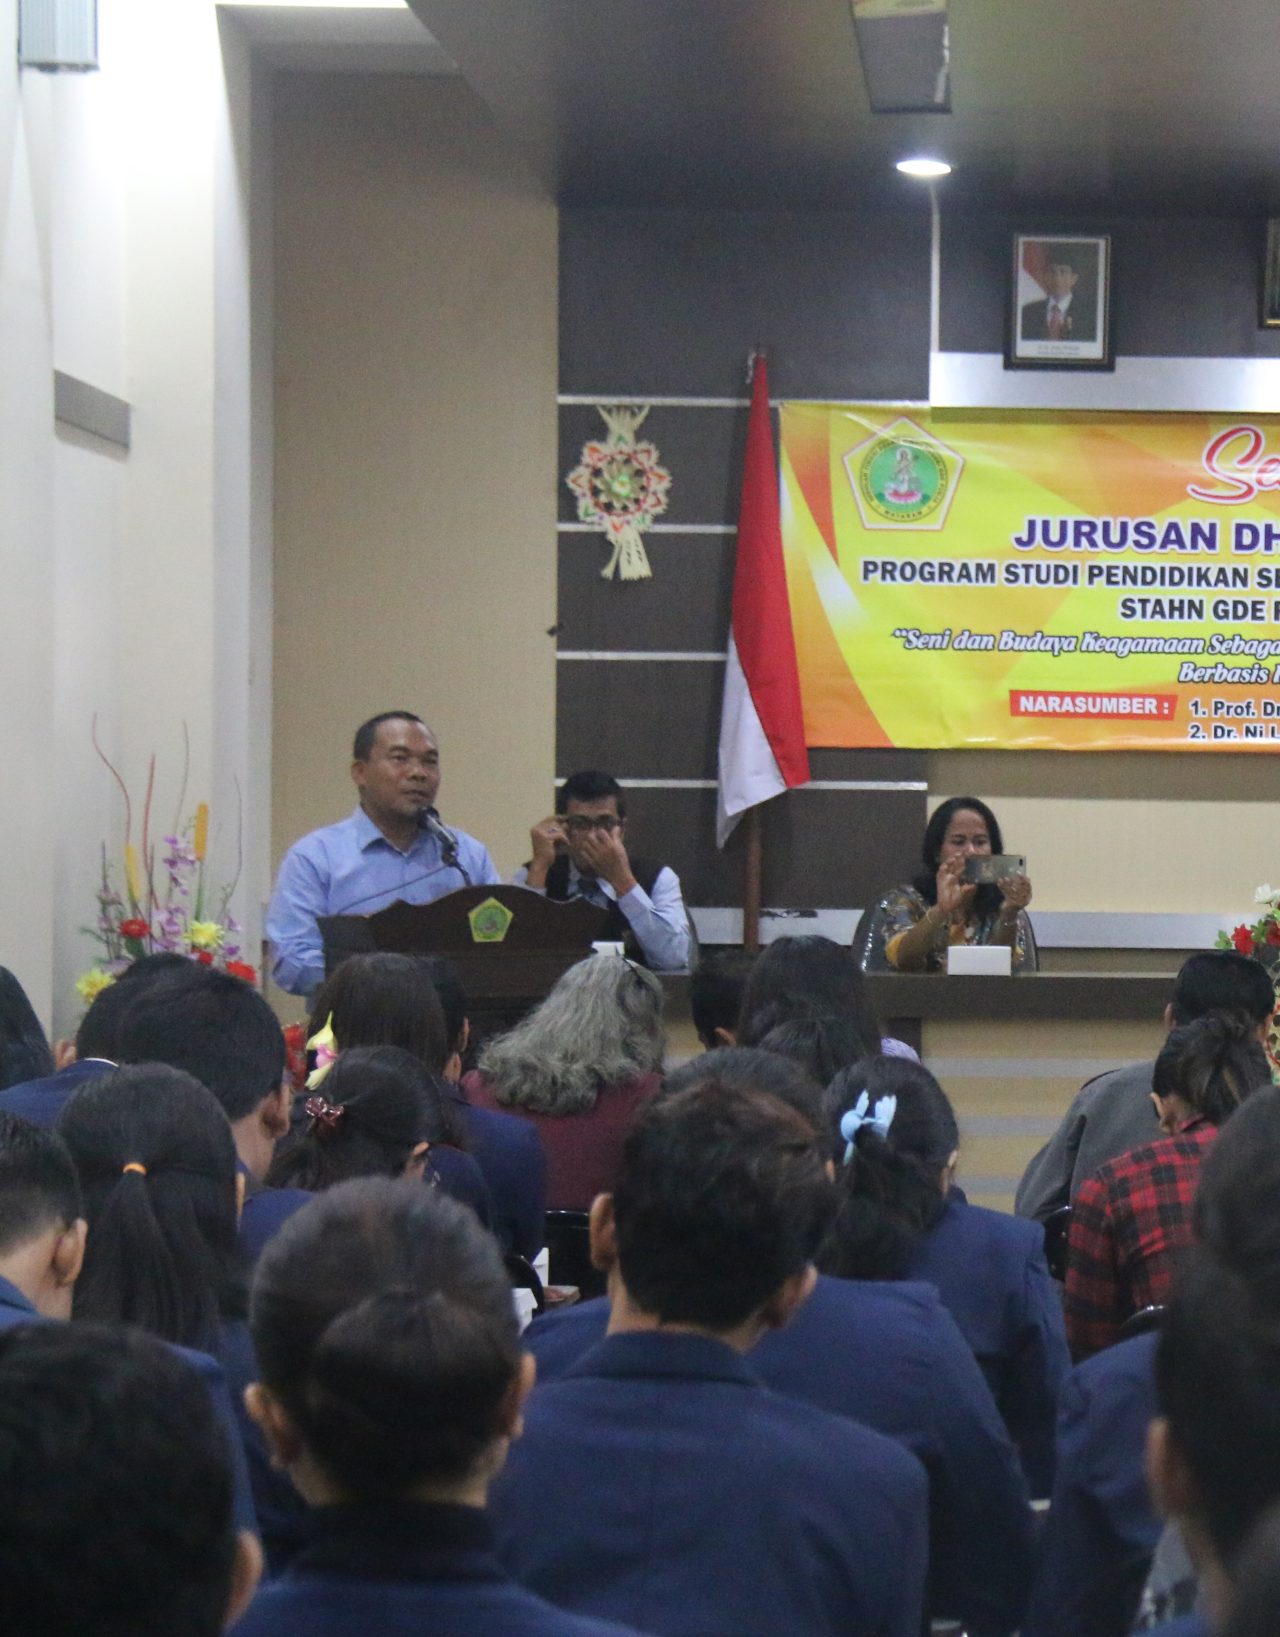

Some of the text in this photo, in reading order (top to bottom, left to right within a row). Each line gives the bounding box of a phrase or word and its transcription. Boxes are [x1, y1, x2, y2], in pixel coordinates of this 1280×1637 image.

[1014, 519, 1218, 551] JURUSAN
[862, 560, 996, 584] PROGRAM
[1003, 563, 1079, 586] STUDI
[1087, 565, 1249, 589] PENDIDIKAN
[1120, 598, 1205, 621] STAHN
[1212, 600, 1266, 622] GDE
[952, 629, 995, 651] dan
[998, 630, 1077, 657] Budaya
[1081, 632, 1205, 658] Keagamaan
[1178, 662, 1271, 684] Berbasis
[1019, 695, 1158, 715] NARASUMBER
[1190, 700, 1207, 717] 1.
[1213, 700, 1256, 718] Prof.
[1190, 724, 1207, 740] 2.
[1213, 725, 1238, 740] Dr.
[1244, 725, 1264, 740] Ni
